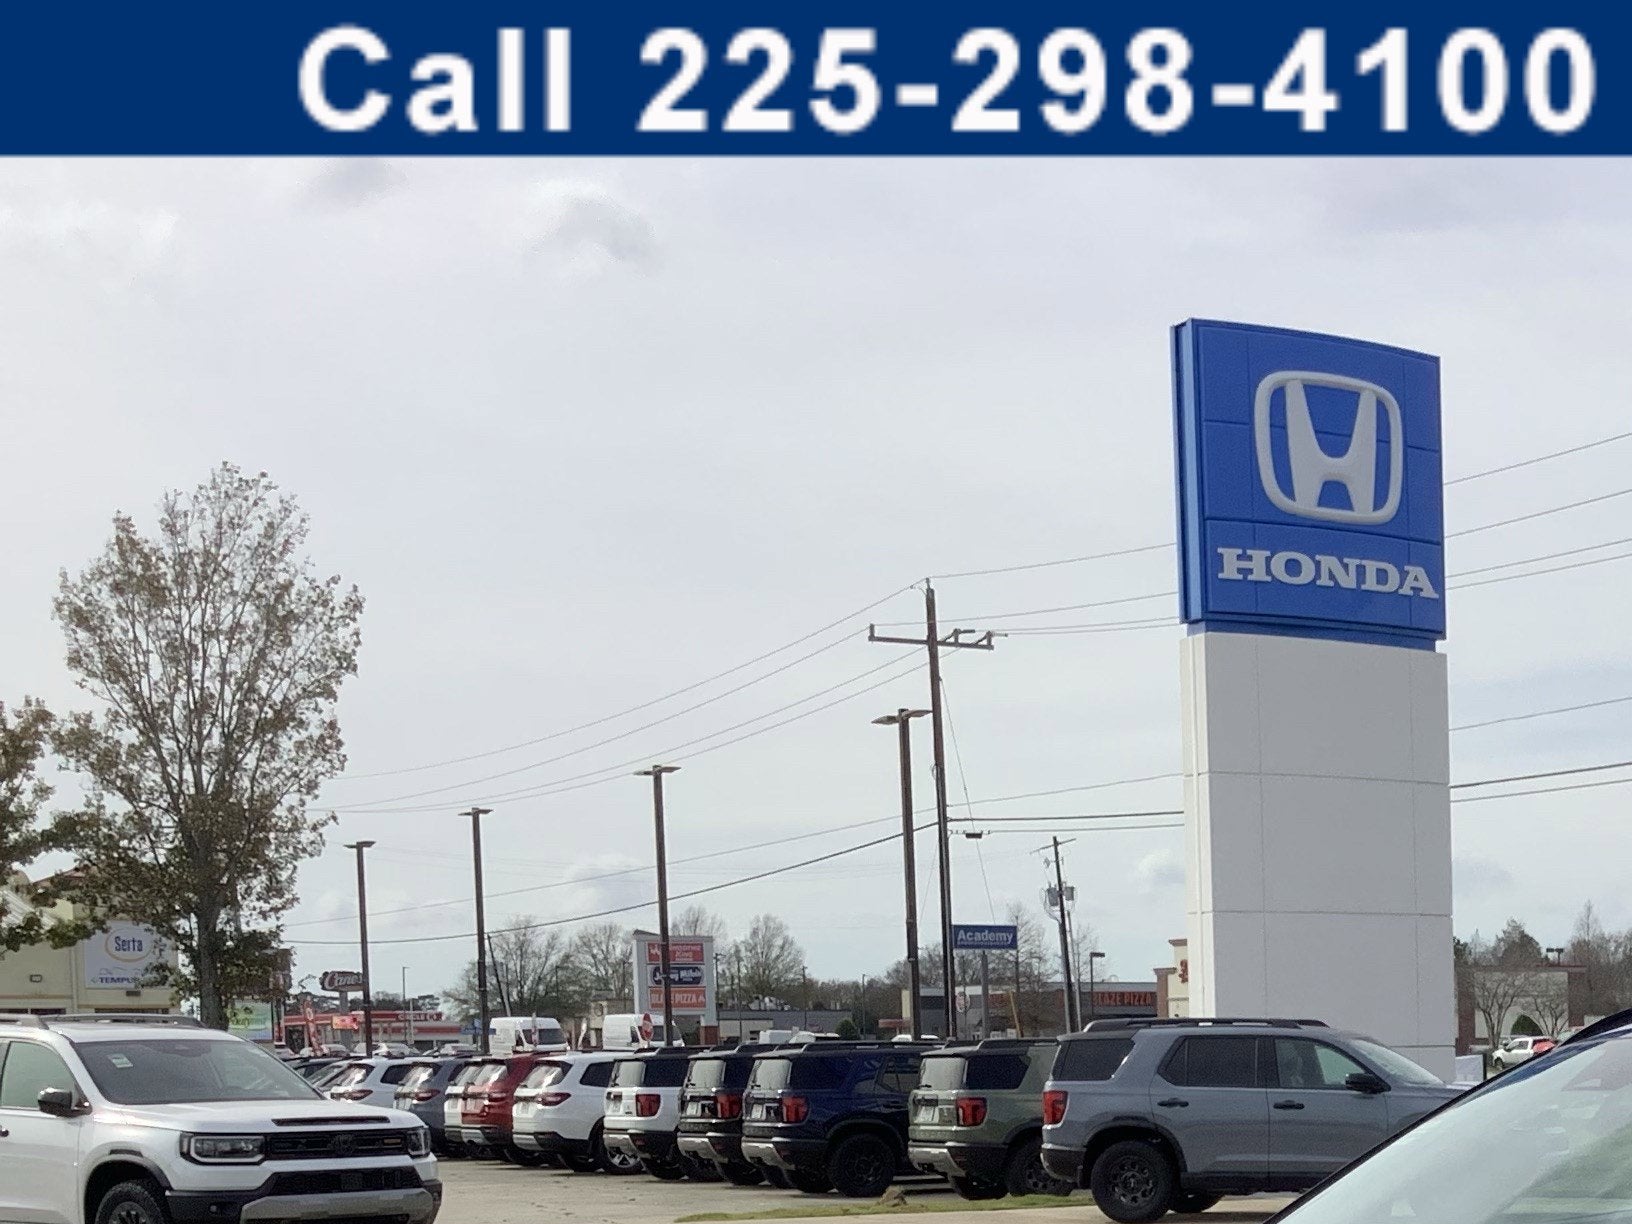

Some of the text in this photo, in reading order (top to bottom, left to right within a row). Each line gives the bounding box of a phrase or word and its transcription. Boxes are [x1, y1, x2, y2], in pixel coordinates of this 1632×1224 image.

[1217, 546, 1439, 599] HONDA
[114, 935, 143, 952] Serta
[957, 929, 1013, 945] Academy
